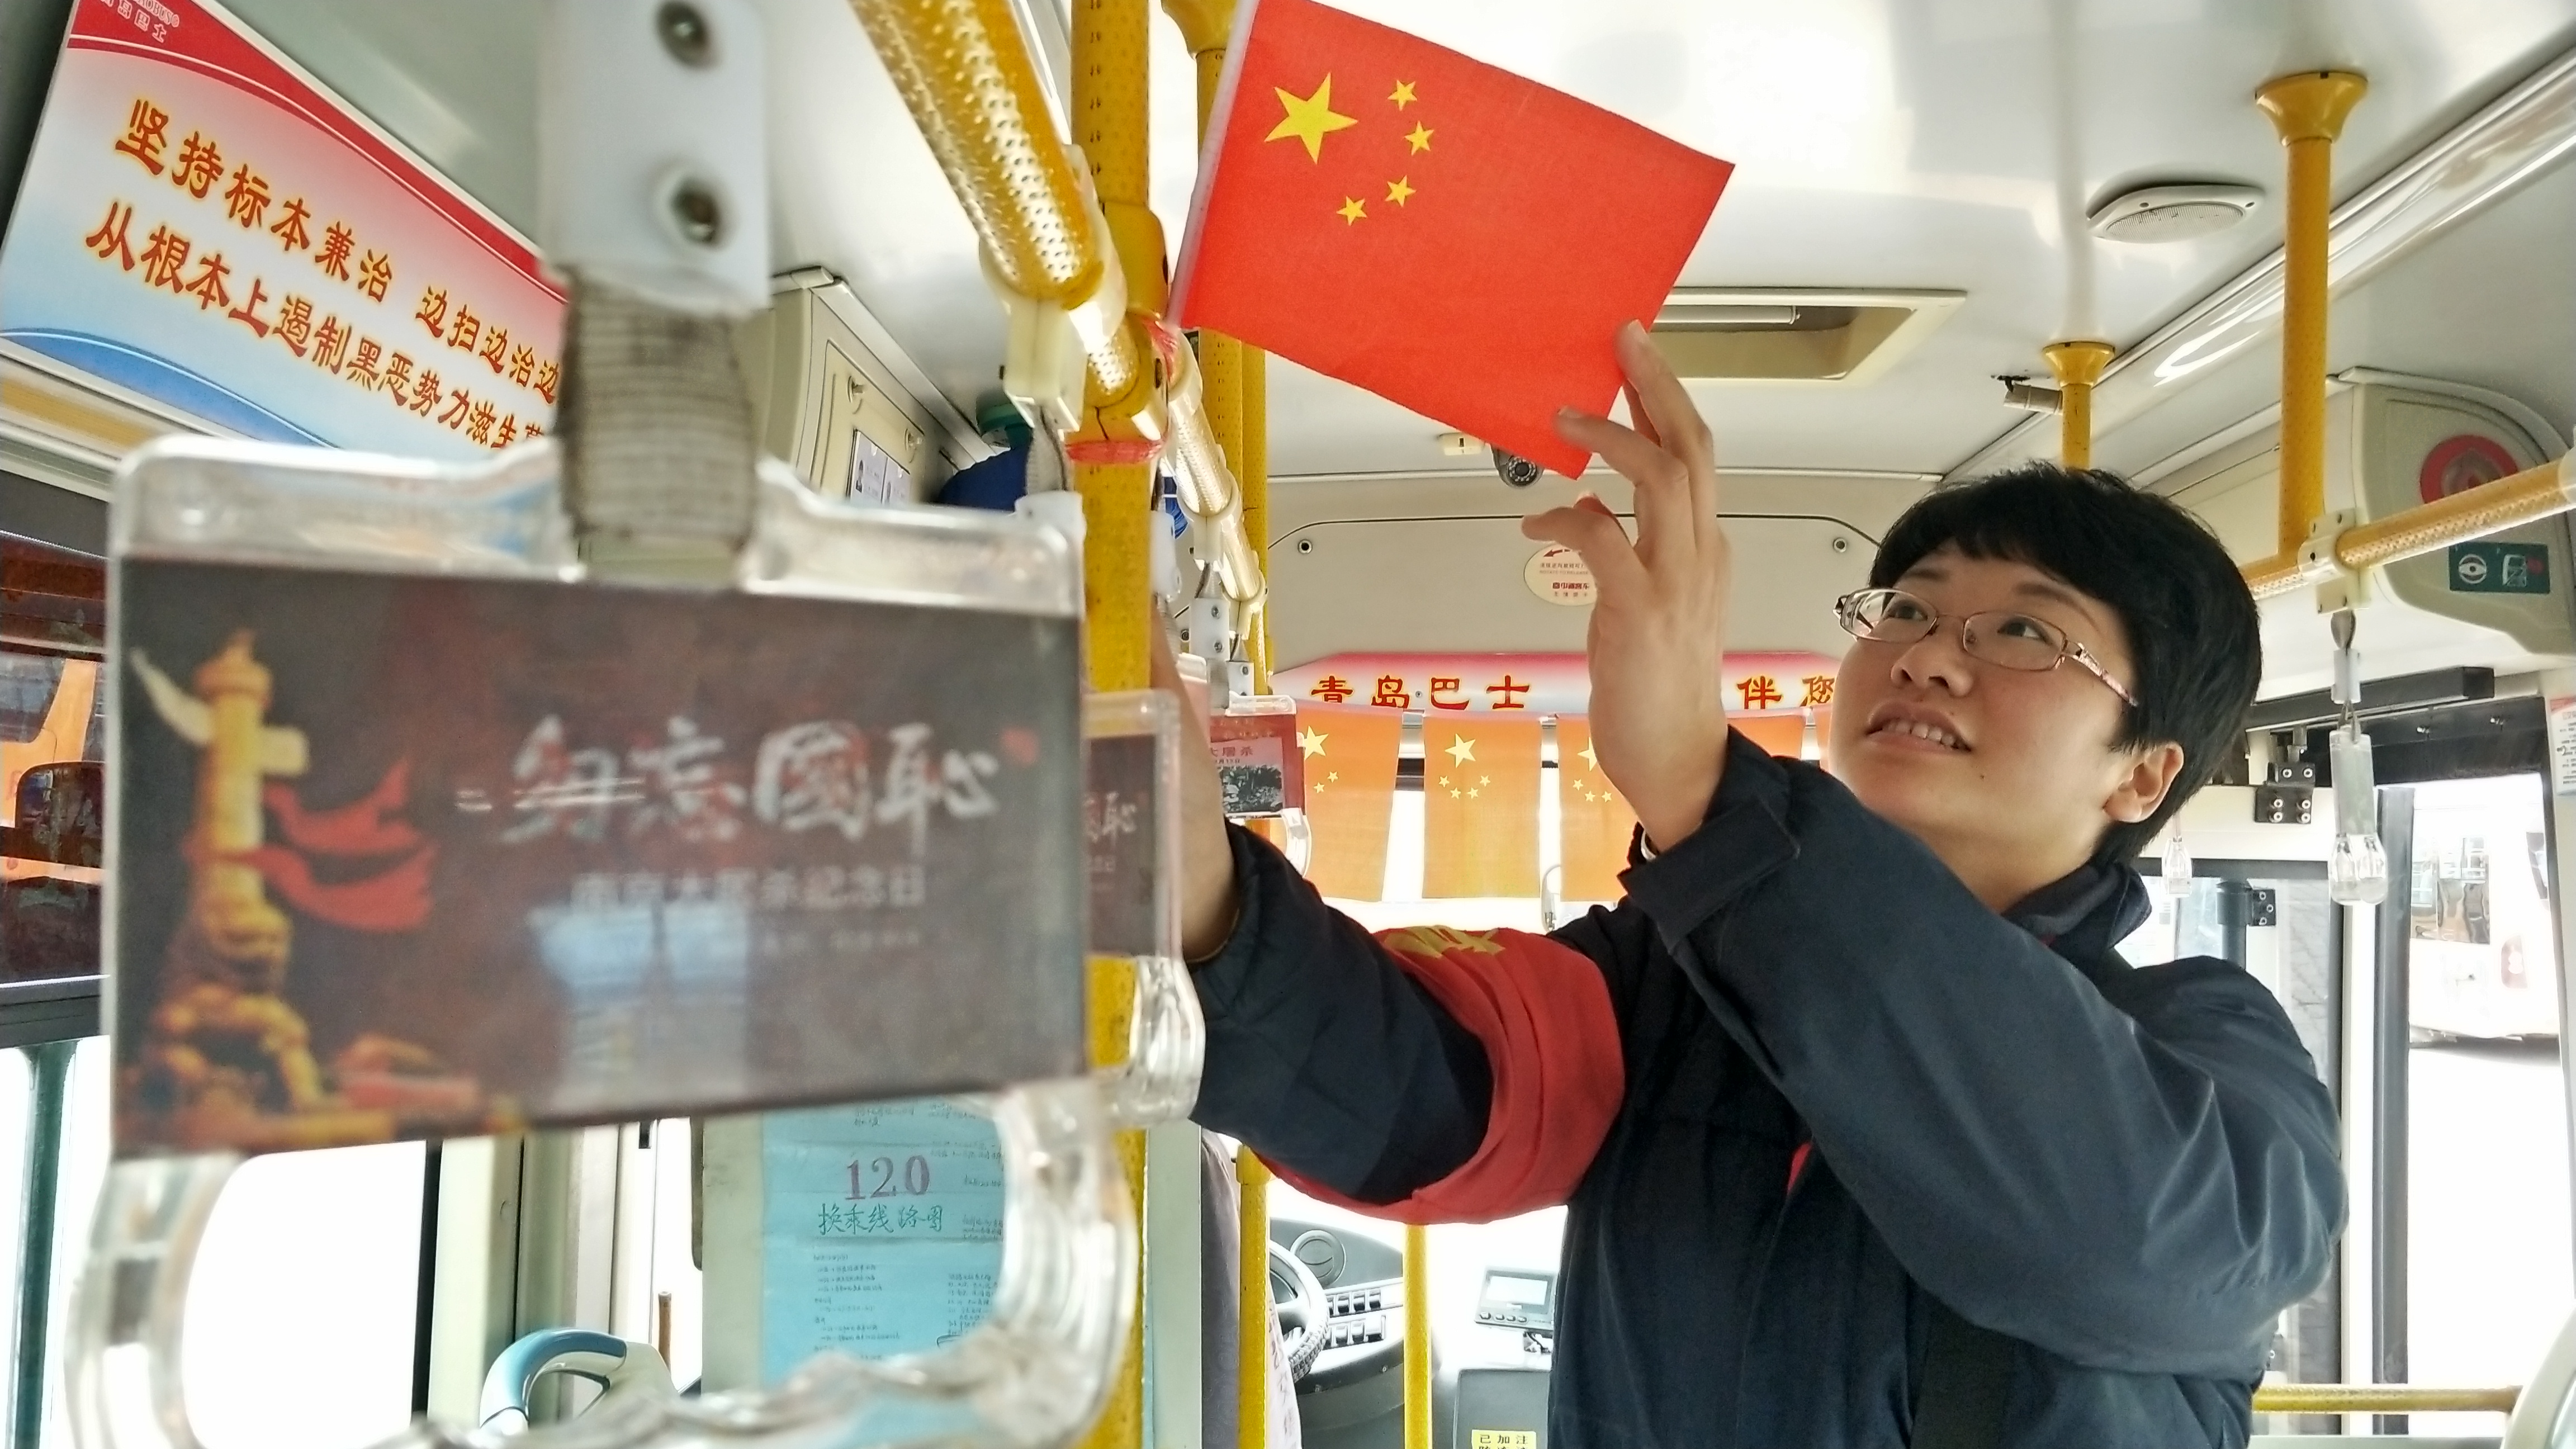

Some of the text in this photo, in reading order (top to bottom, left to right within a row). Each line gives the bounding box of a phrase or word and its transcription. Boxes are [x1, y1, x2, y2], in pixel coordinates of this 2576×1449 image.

[101, 0, 167, 43] 岛巴士
[115, 99, 559, 404] 坚持标本兼治 边扫边治边
[1311, 675, 1835, 710] 青岛巴士 伴您
[844, 1154, 931, 1200] 120
[818, 1202, 944, 1235] 换乘线路图
[1479, 1433, 1528, 1445] 已加注
